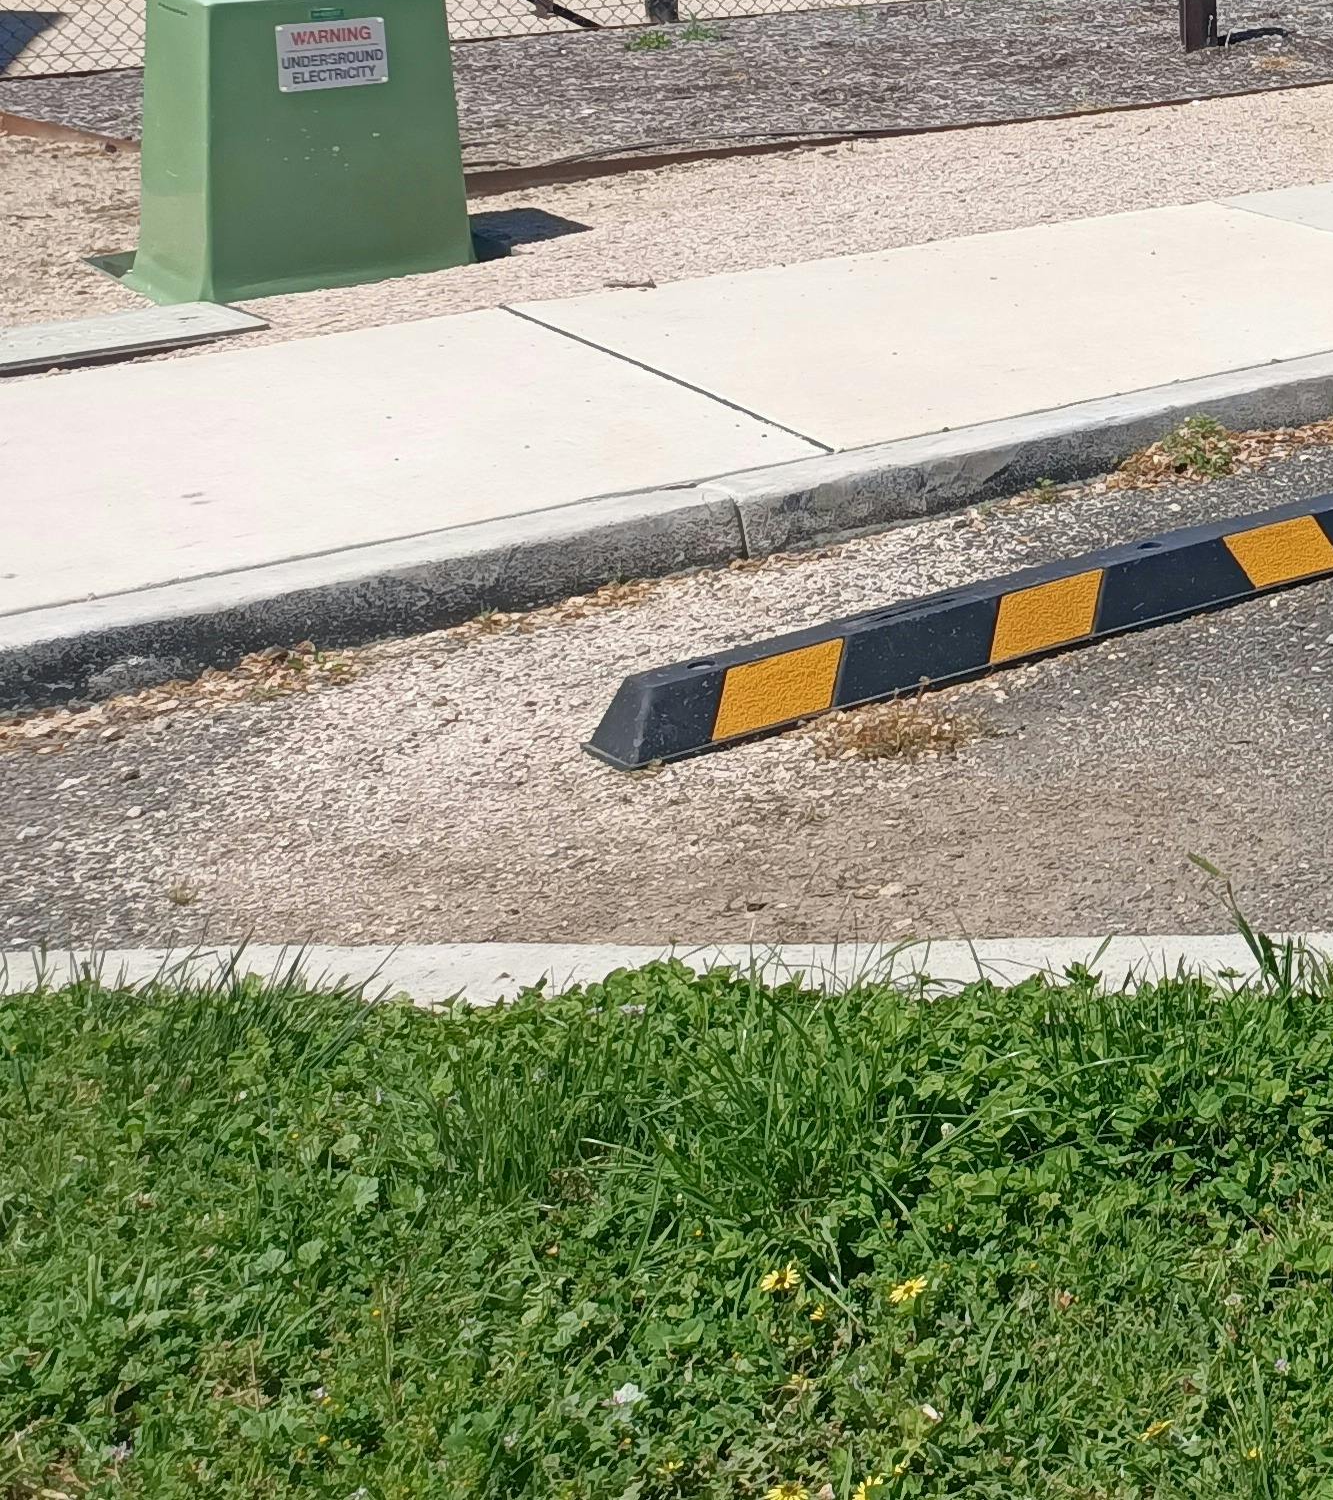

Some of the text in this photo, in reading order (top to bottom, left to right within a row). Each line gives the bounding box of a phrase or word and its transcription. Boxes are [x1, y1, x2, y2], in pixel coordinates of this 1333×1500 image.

[291, 26, 372, 46] WARNING
[282, 49, 384, 69] UNDERGROUND
[292, 65, 377, 84] ELECTRICITY
